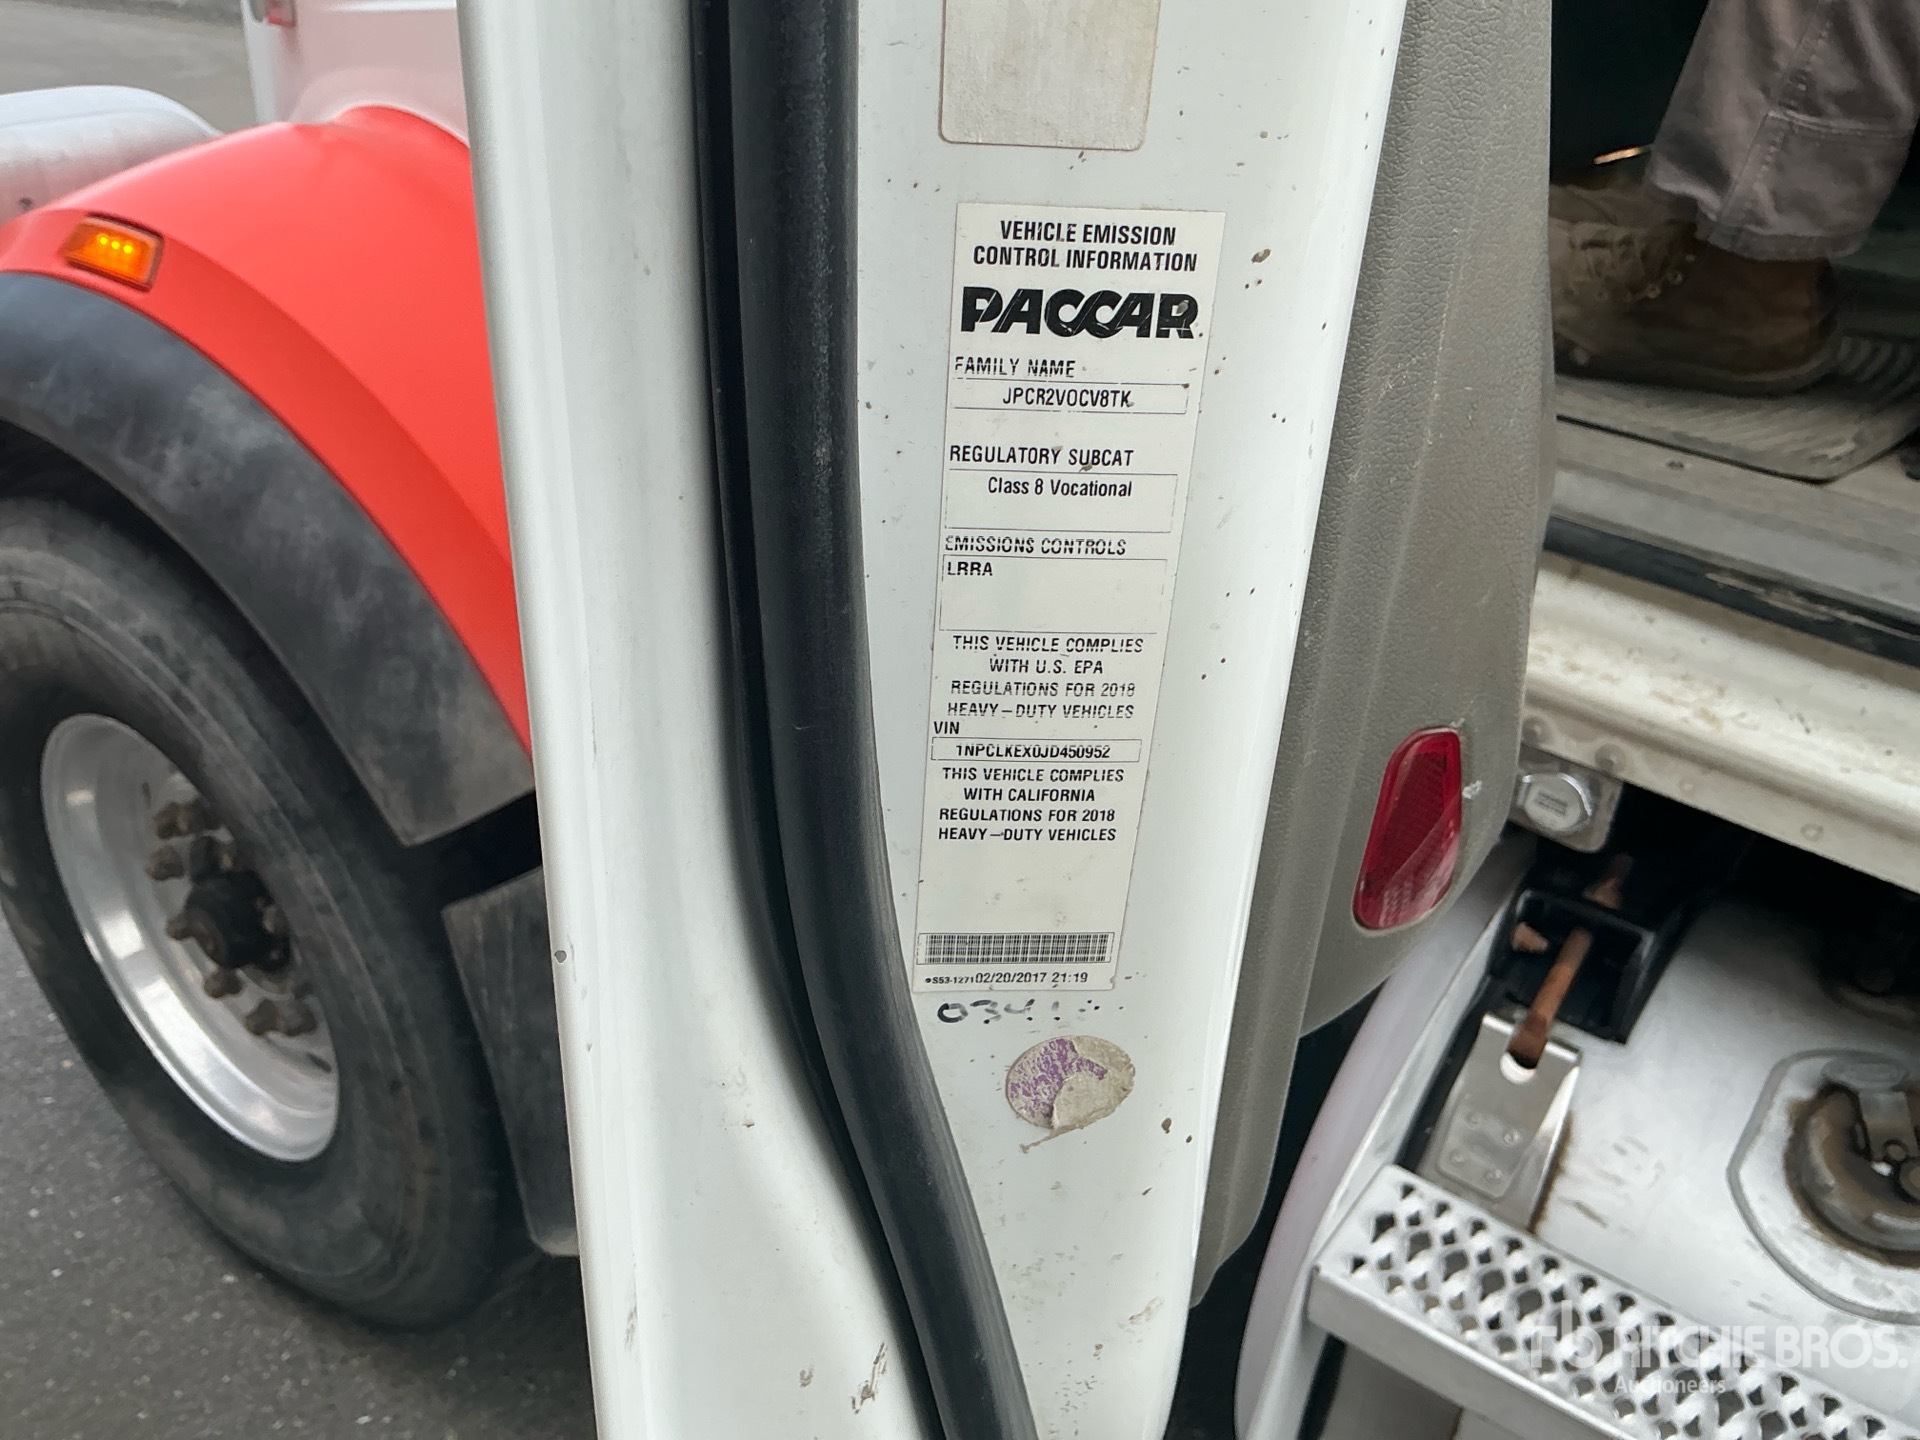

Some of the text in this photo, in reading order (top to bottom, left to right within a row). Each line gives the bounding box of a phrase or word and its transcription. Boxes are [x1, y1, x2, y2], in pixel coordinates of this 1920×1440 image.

[1001, 220, 1177, 247] VEHICLE EMISSION
[974, 246, 1198, 272] CONTROL INFORMATION
[961, 286, 1199, 340] PACCAR
[955, 356, 1076, 378] FAMILY NAME
[950, 445, 1135, 467] REGULATORY SUBCAT
[988, 476, 1133, 498] Class 8 Vocational
[945, 535, 1127, 556] EMISSIONS CONTROLS
[947, 561, 994, 577] LRRA
[953, 635, 1145, 653] THIS VEHICLE COMPLIES
[989, 658, 1104, 675] WITH U.S. EPA
[950, 680, 1059, 697] REGULATIONS
[1064, 682, 1096, 697] FOR
[1062, 704, 1135, 719] VEHICLES
[933, 721, 960, 735] VIN
[942, 767, 1125, 783] THIS VEHICLE COMPLIES
[963, 788, 1096, 802] WITH CALIFORNIA
[938, 808, 1116, 822] REGULATIONS FOR 2018
[1048, 829, 1117, 841] VEHICLES
[1051, 971, 1089, 984] 21:19
